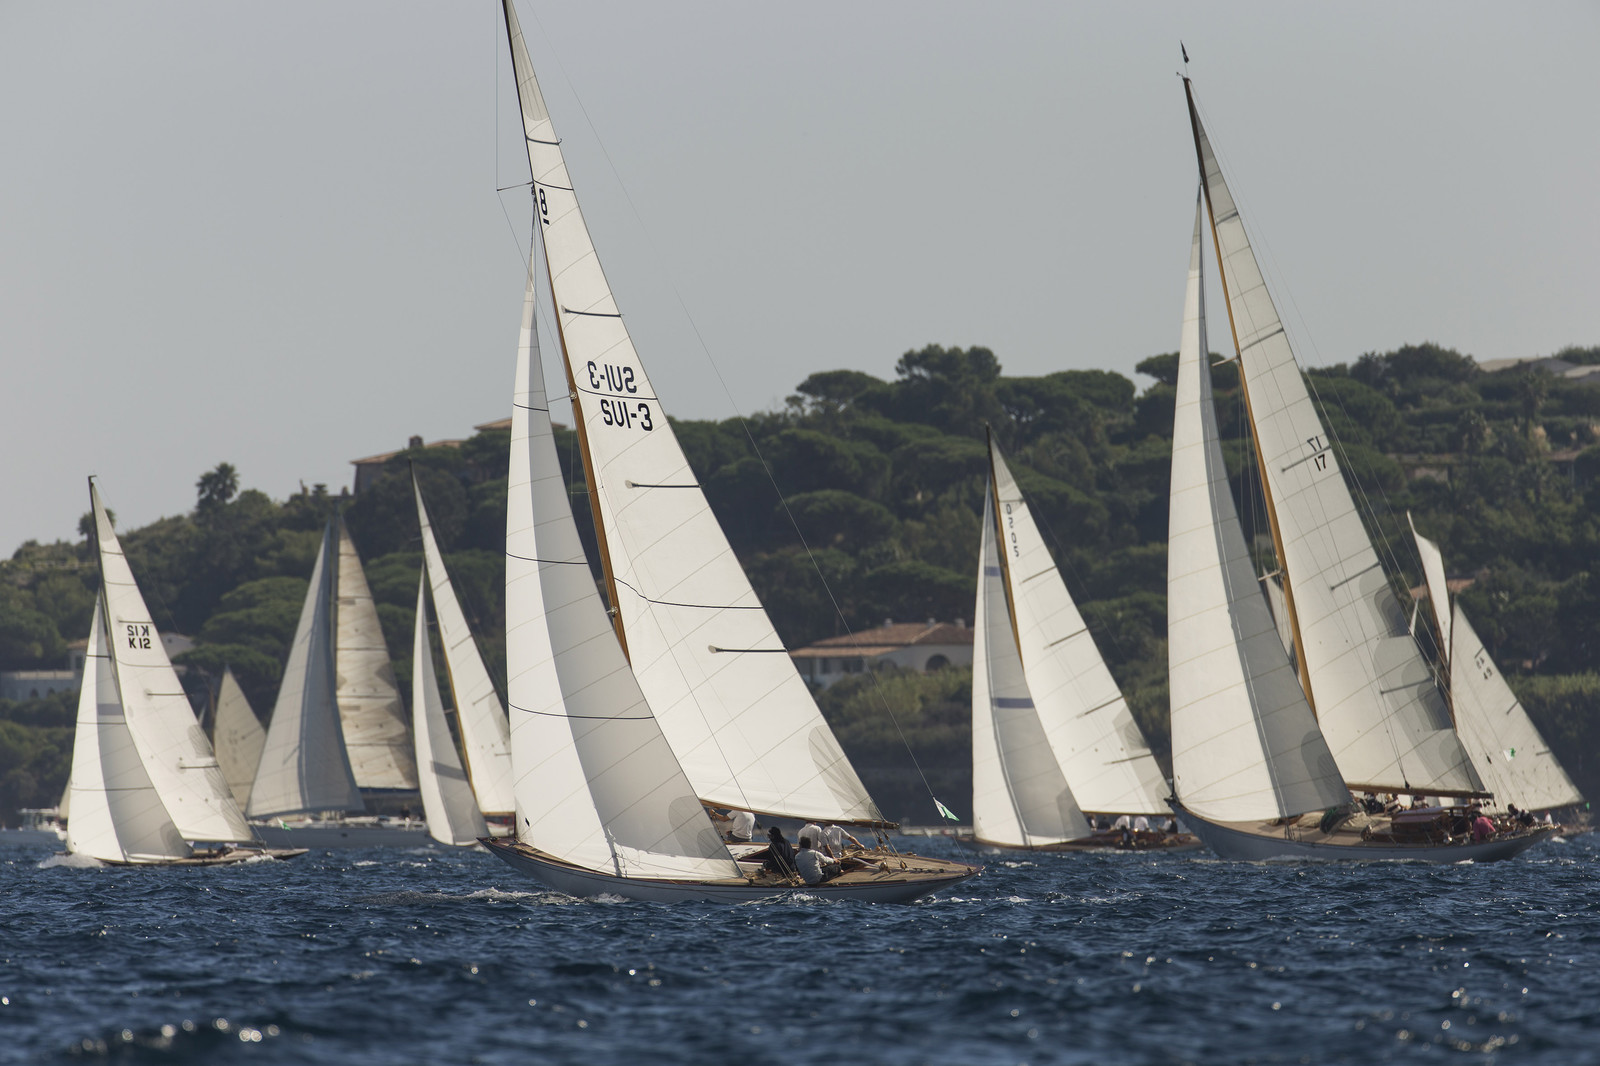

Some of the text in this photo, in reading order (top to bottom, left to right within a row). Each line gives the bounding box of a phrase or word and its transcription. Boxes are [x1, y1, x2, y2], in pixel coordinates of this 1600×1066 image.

[539, 187, 548, 216] 8
[600, 398, 654, 432] SUI-3
[1314, 453, 1327, 472] 17
